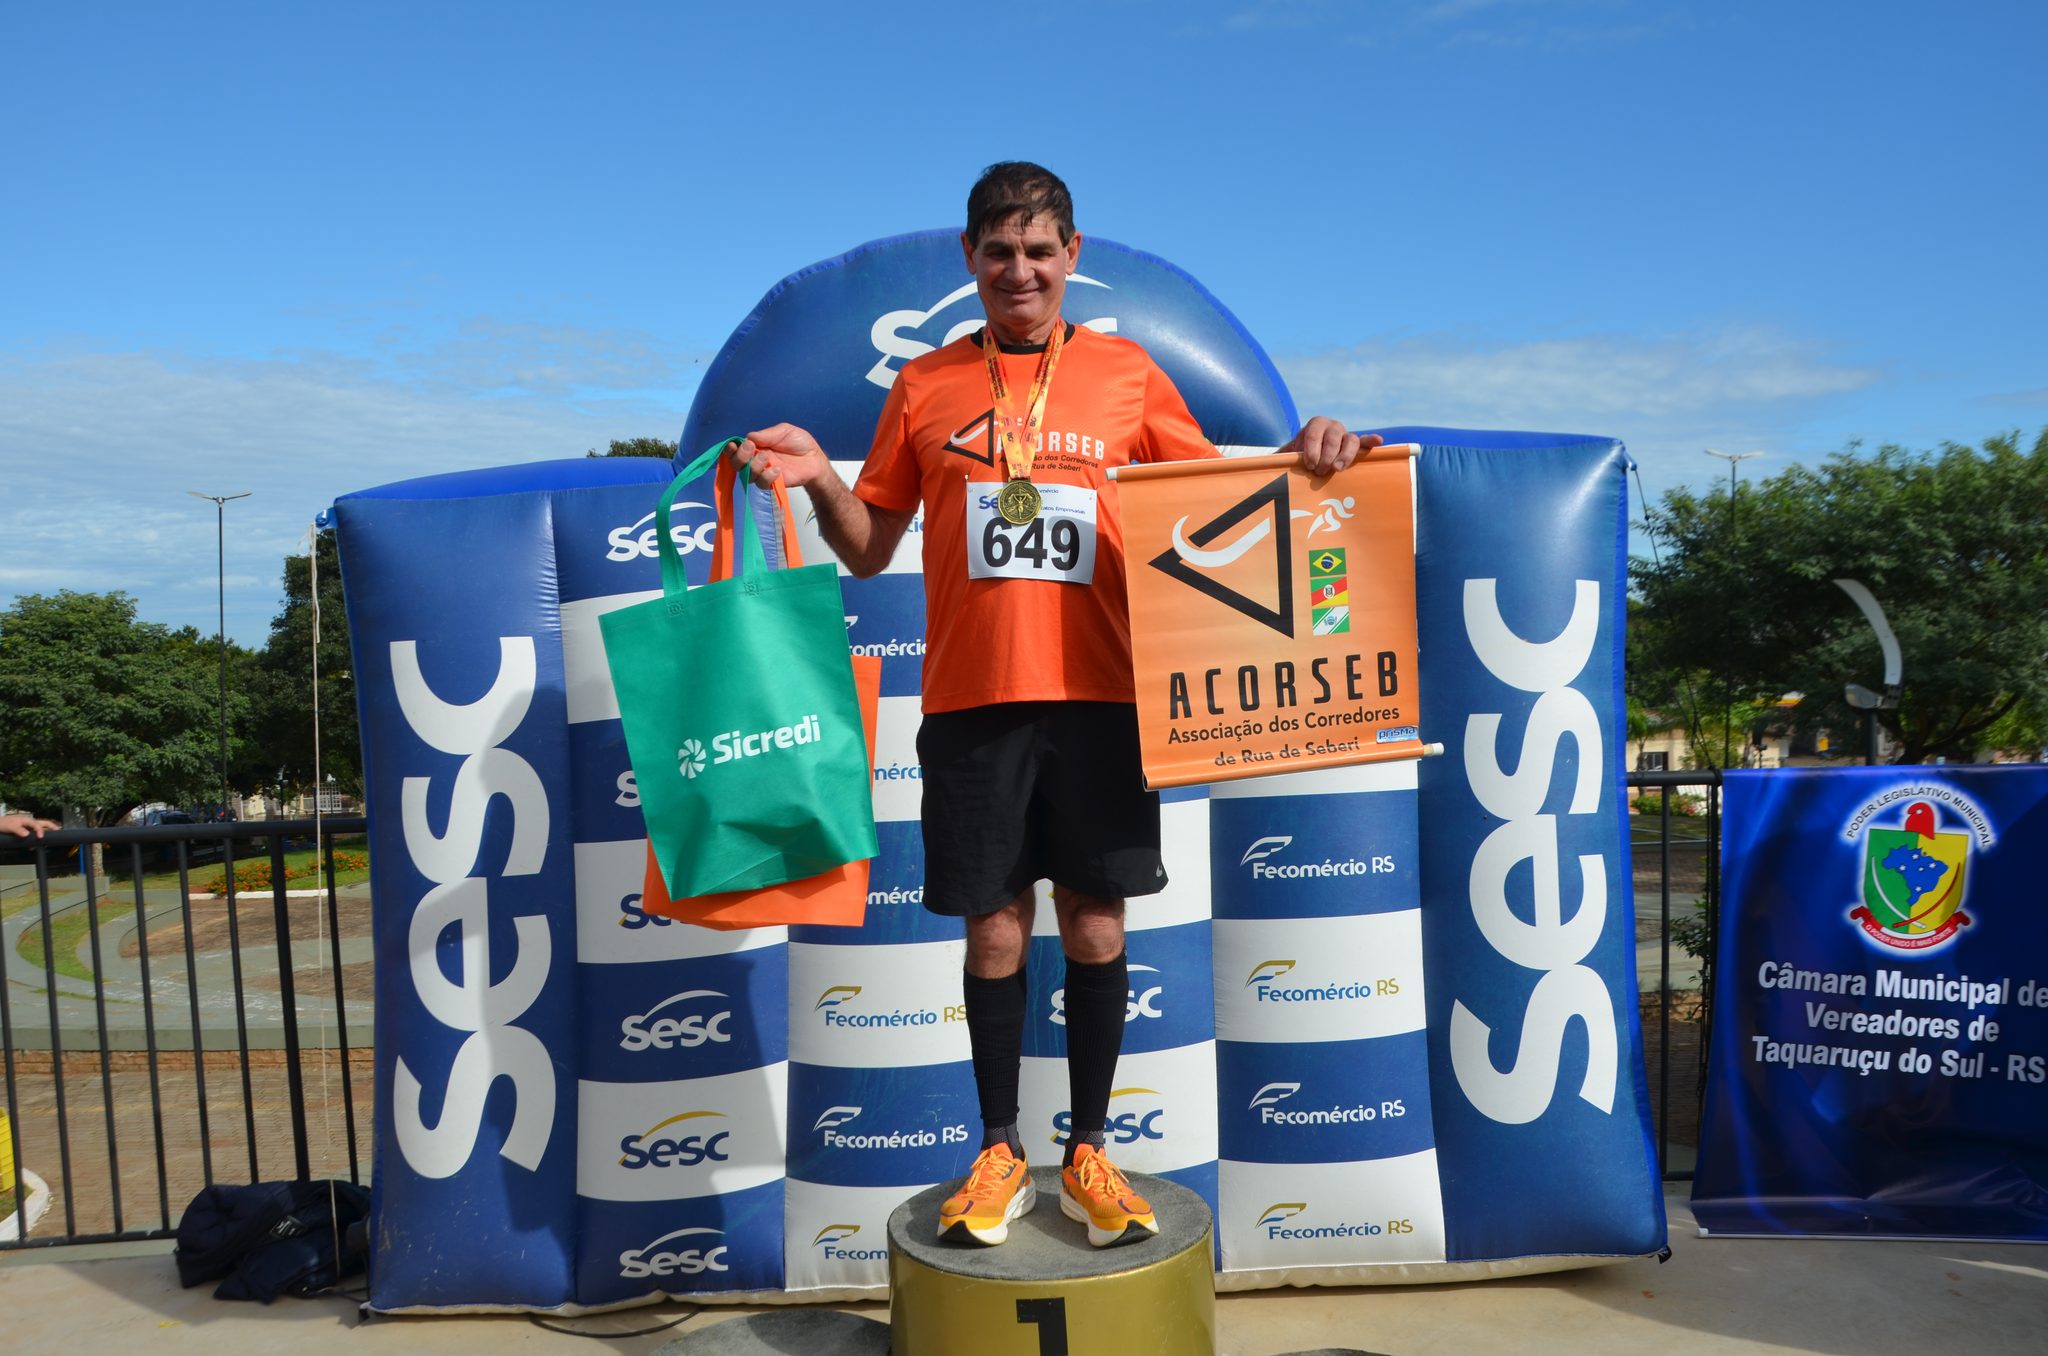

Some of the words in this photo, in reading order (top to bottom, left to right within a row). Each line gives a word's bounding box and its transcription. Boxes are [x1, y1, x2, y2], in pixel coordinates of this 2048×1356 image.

[982, 516, 1080, 572] 649
[1170, 651, 1398, 720] ACORSEB
[712, 714, 821, 764] Sicredi
[1168, 719, 1262, 744] Associação
[1269, 715, 1299, 733] dos
[1305, 706, 1400, 729] Corredores
[1214, 752, 1236, 767] de
[1241, 748, 1275, 764] Rua
[1279, 743, 1301, 759] de
[1305, 736, 1360, 756] Seberi
[1847, 804, 1877, 838] PODER
[1877, 787, 1952, 807] LEGISLATIVO
[1952, 797, 1992, 848] MUNICIPAL
[1253, 858, 1367, 880] Fecomércio
[1372, 855, 1395, 873] RS
[1258, 981, 1371, 1003] Fecomércio
[1377, 979, 1399, 996] RS
[1758, 960, 1867, 996] Câmara
[1874, 969, 2010, 1010] Municipal
[2018, 979, 2048, 1008] de
[825, 1008, 937, 1027] Fecomércio
[943, 1005, 967, 1023] RS
[1805, 1001, 1960, 1039] Vereadores
[1967, 1014, 2000, 1042] de
[1752, 1036, 1891, 1076] Taquaruçu
[1898, 1047, 1932, 1074] do
[1940, 1049, 1984, 1078] Sul
[2007, 1054, 2046, 1083] RS
[1261, 1104, 1376, 1126] Fecomércio
[1381, 1099, 1406, 1118] RS
[824, 1129, 936, 1149] Fecomércio
[942, 1124, 969, 1144] RS
[1268, 1220, 1382, 1241] Fecomércio
[1388, 1218, 1413, 1235] RS
[824, 1246, 888, 1260] Fecom
[1016, 1297, 1069, 1356] 1
